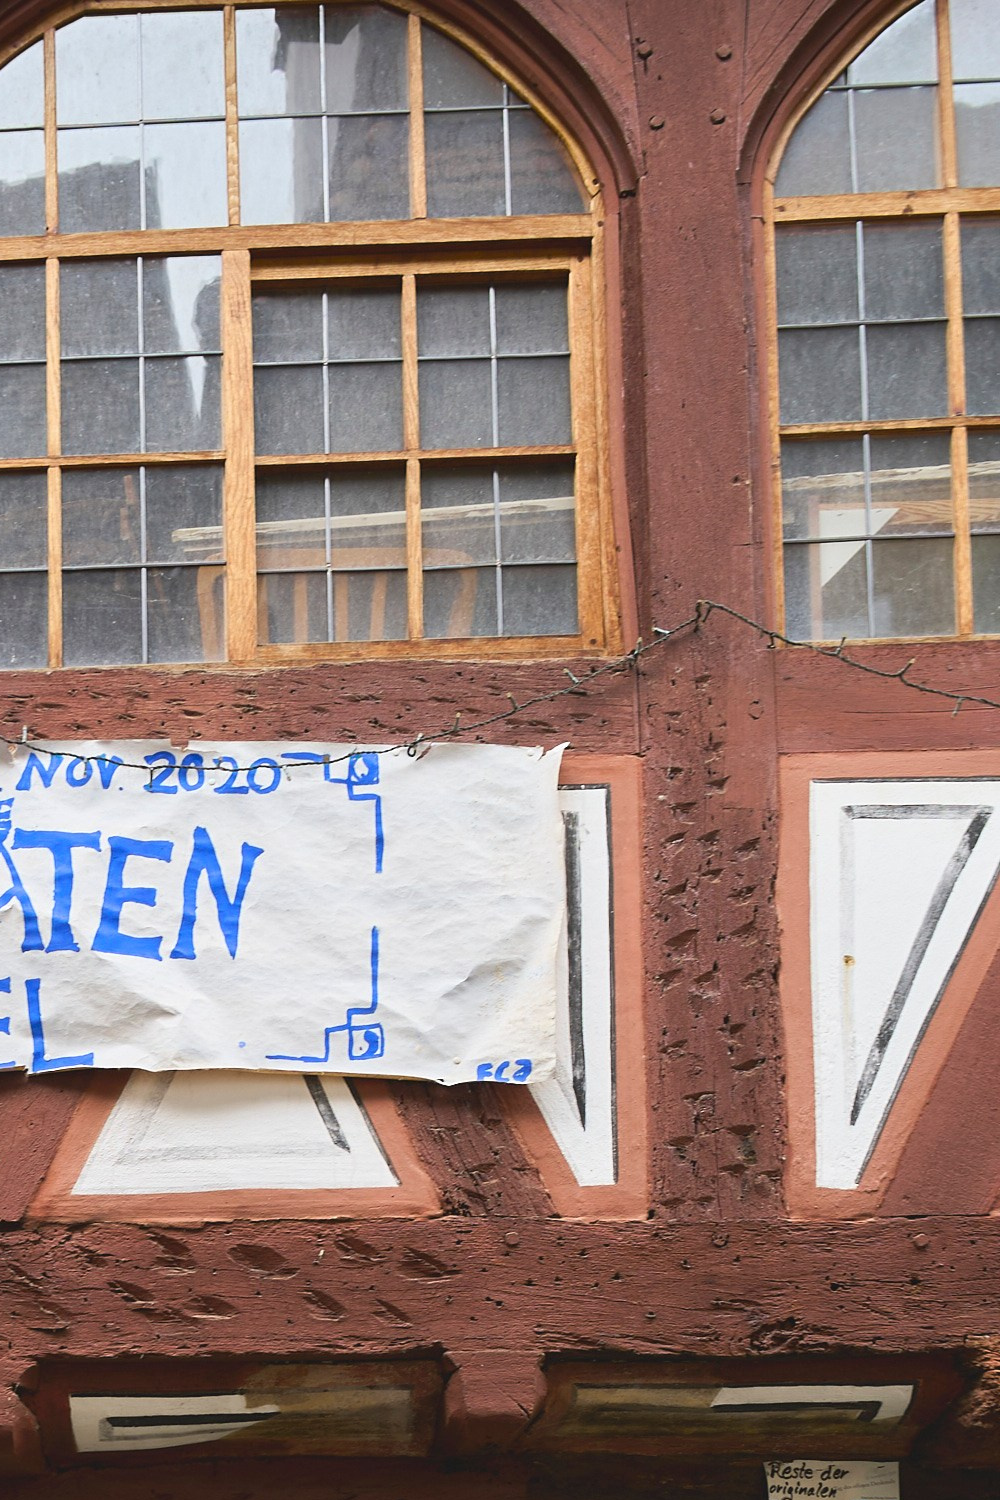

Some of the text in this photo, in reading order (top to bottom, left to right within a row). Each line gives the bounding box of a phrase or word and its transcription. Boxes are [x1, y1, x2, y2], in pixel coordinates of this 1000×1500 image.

[143, 751, 284, 795] 2020
[768, 1461, 849, 1481] Reste der
